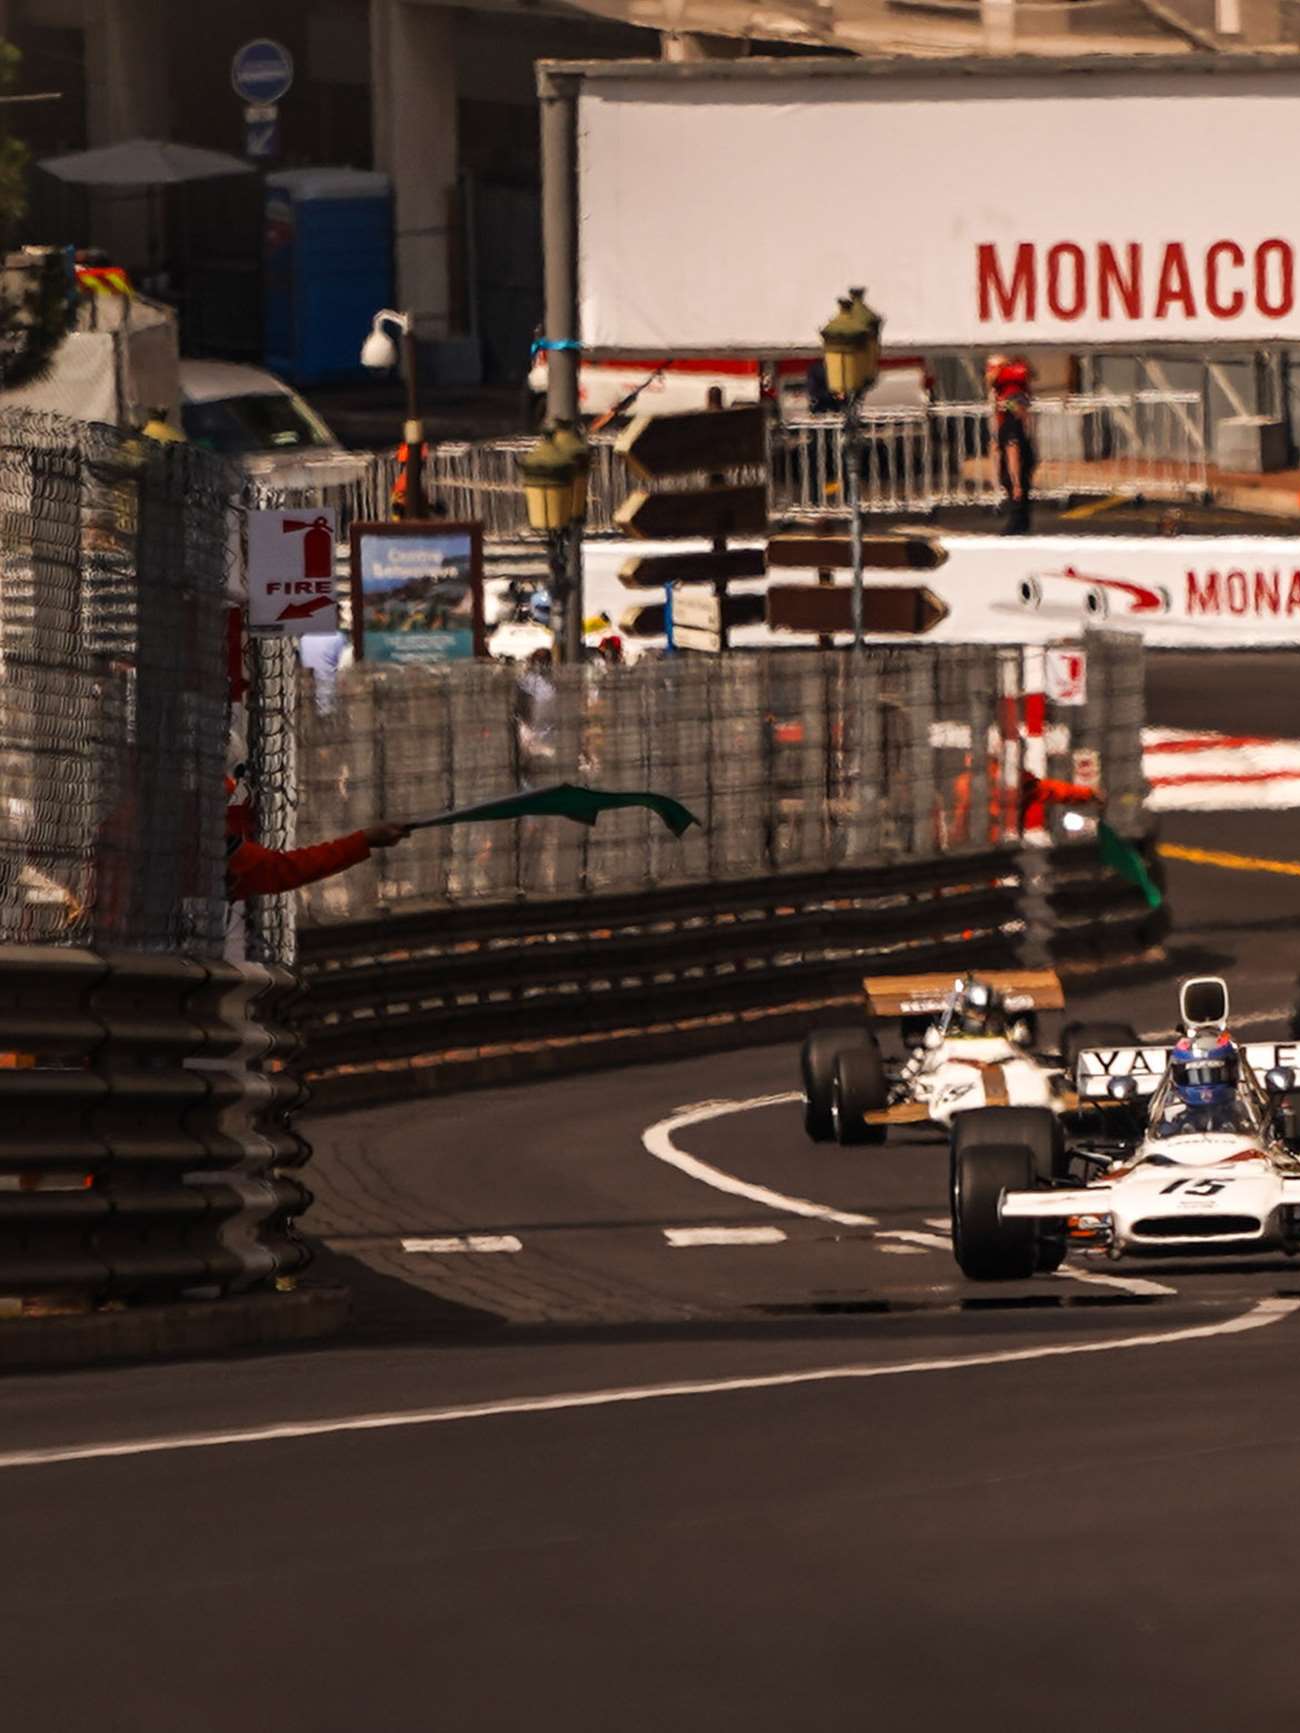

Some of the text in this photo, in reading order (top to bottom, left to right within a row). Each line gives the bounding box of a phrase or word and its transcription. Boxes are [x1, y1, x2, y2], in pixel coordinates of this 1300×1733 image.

[977, 239, 1295, 321] MONACO
[266, 581, 333, 595] FIRE
[1159, 1178, 1236, 1196] 15
